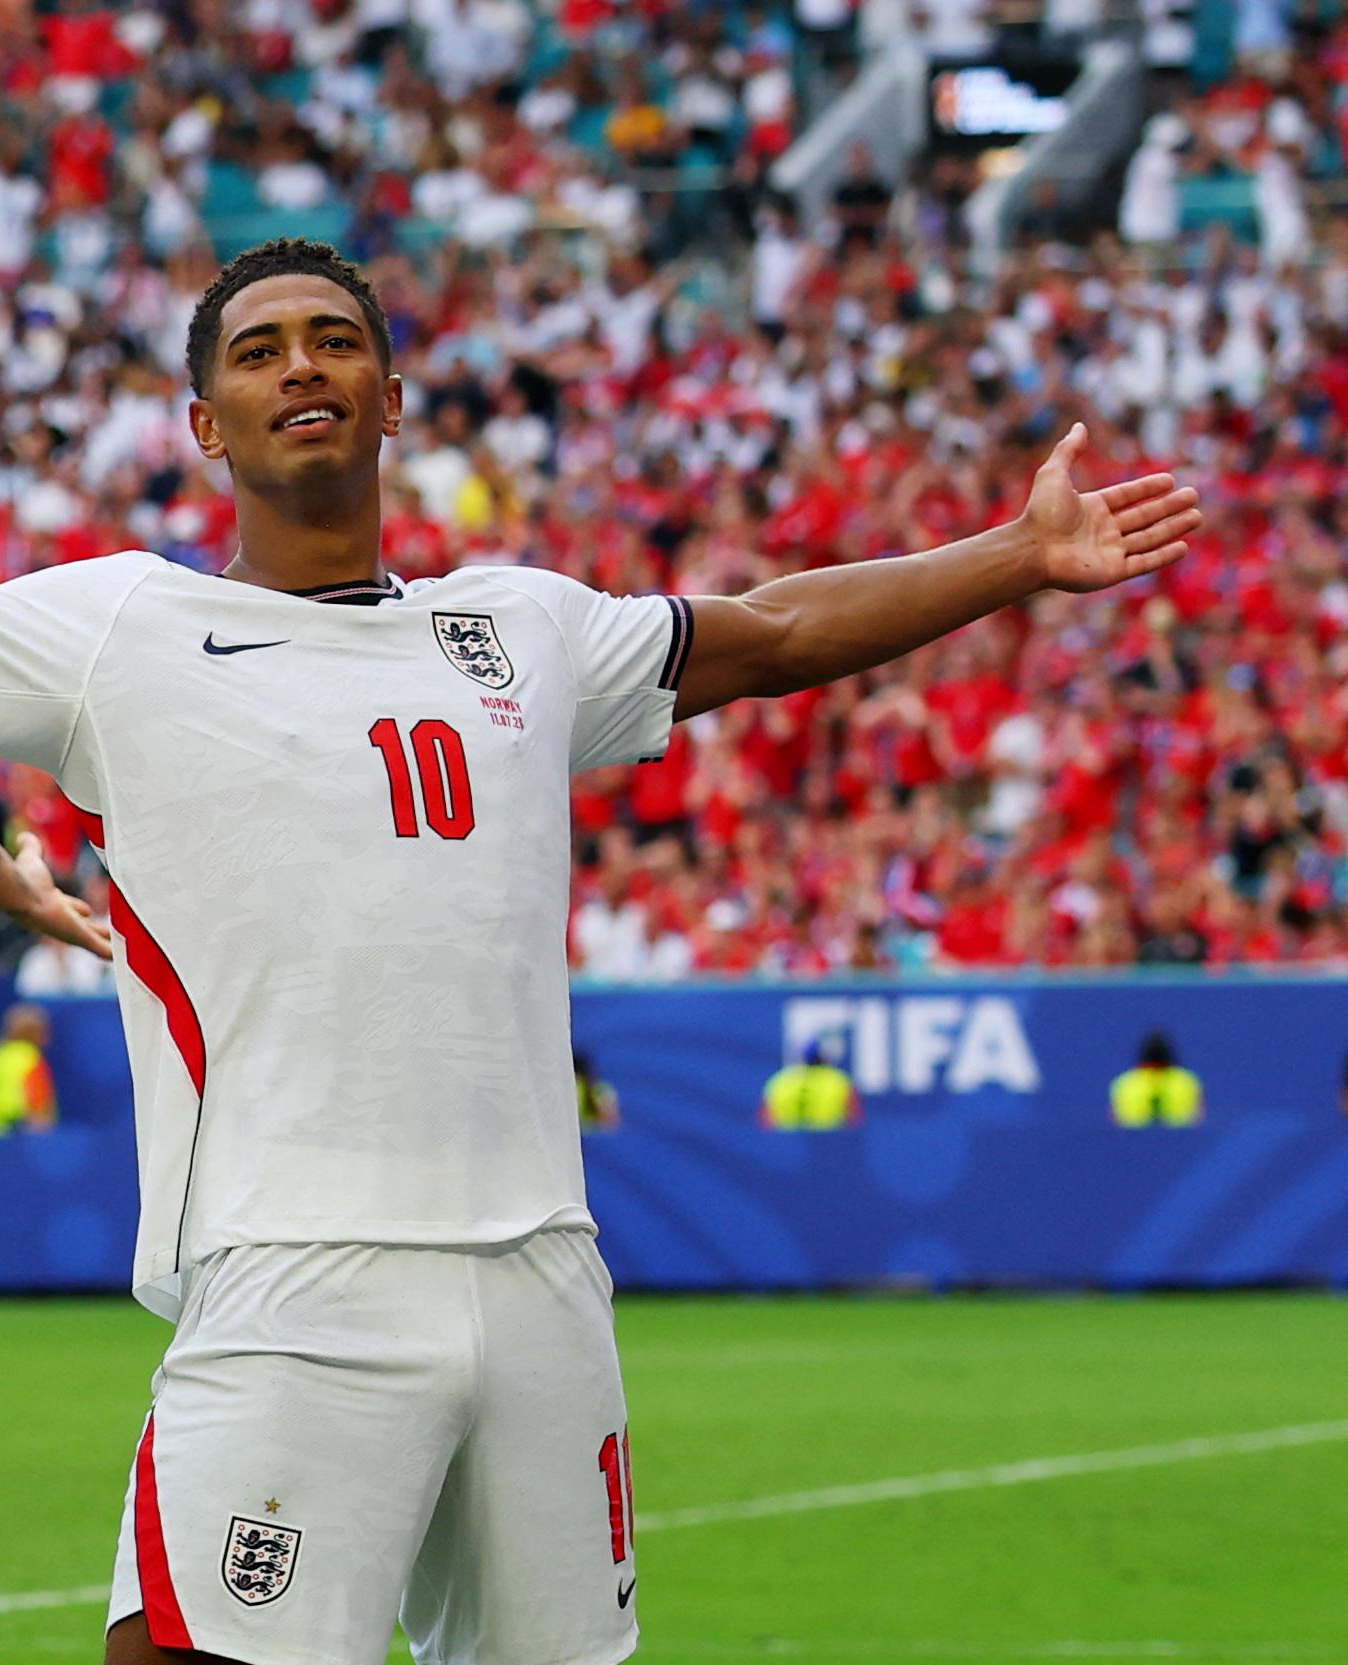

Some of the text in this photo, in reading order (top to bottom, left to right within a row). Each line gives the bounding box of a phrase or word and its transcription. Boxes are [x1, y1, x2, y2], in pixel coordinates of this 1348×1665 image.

[479, 696, 522, 713] NORWAY
[368, 718, 475, 840] 10
[784, 998, 1041, 1094] FIFA
